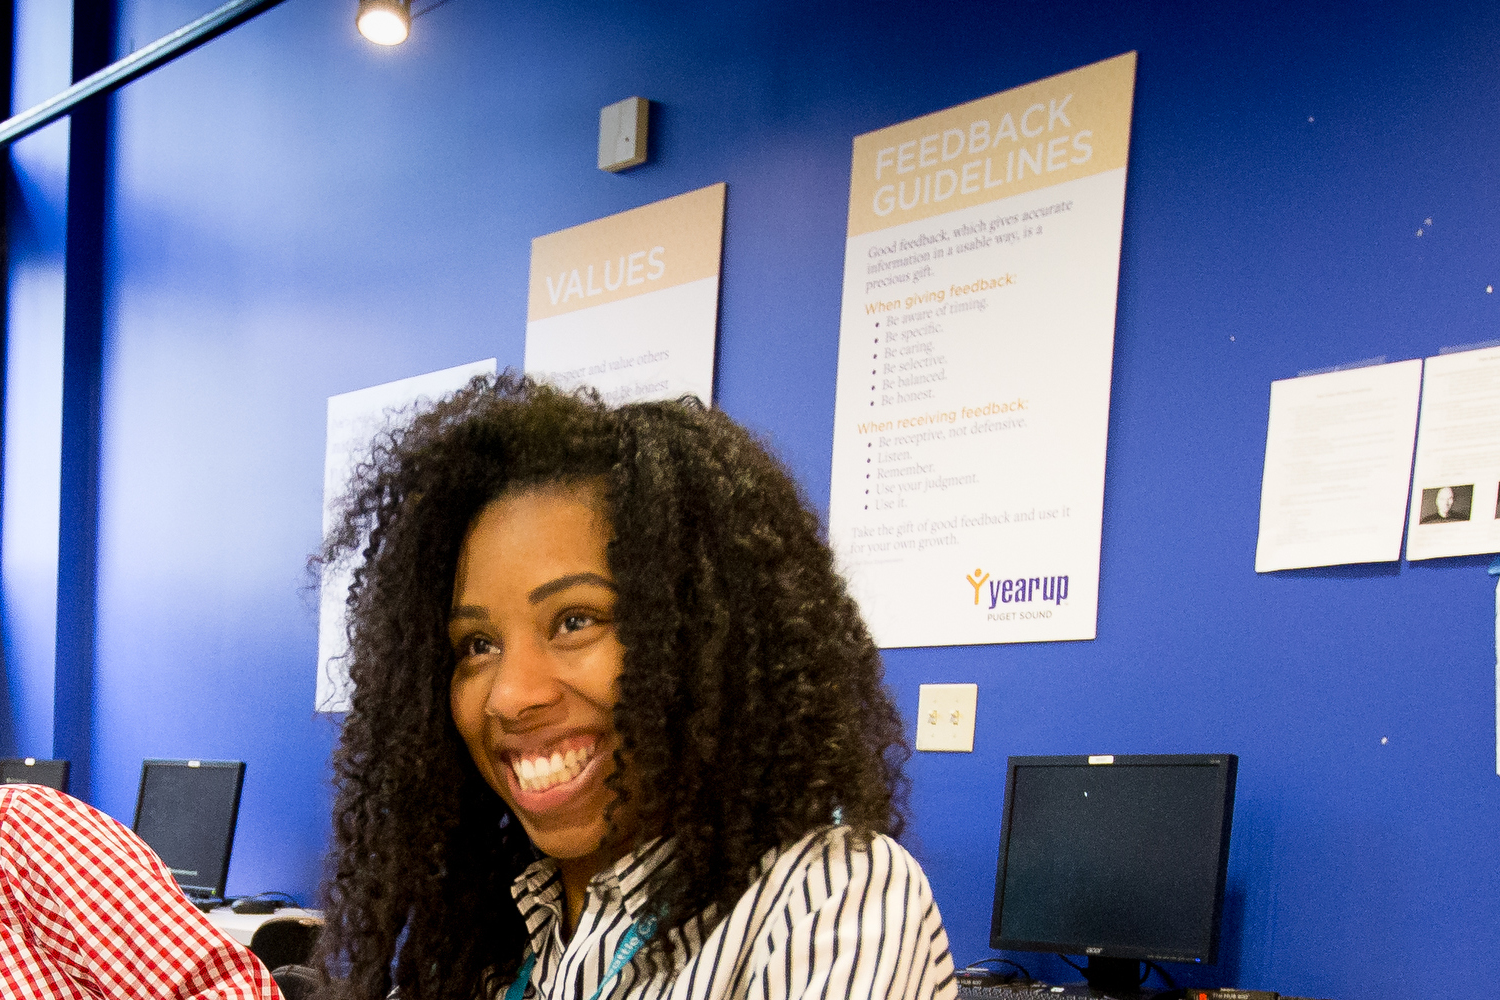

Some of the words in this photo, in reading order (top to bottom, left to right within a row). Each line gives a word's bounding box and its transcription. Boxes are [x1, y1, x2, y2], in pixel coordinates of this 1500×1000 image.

[875, 94, 1073, 180] FEEDBACK
[872, 129, 1093, 217] GUIDELINES
[868, 241, 897, 258] Good
[900, 229, 950, 251] feedback,
[953, 220, 987, 238] which
[989, 214, 1019, 232] gives
[1021, 200, 1074, 221] accurate
[867, 251, 931, 274] information
[933, 247, 944, 259] in
[947, 246, 953, 256] a
[956, 235, 991, 254] usable
[994, 231, 1020, 246] way,
[1022, 226, 1033, 239] is
[1036, 224, 1043, 235] a
[546, 246, 665, 305] VALUES
[865, 272, 911, 294] precious
[912, 264, 935, 284] gift.
[865, 299, 901, 315] When
[905, 289, 945, 309] giving
[950, 273, 1017, 297] feedback:
[886, 315, 899, 327] Be
[901, 310, 933, 324] aware
[935, 302, 949, 316] of
[885, 331, 898, 343] Be
[588, 360, 606, 375] and
[636, 350, 670, 365] others
[884, 347, 897, 359] Be
[883, 362, 896, 375] Be
[882, 378, 895, 390] Be
[881, 394, 894, 406] Be
[857, 420, 893, 435] When
[897, 411, 957, 429] receiving
[961, 398, 1028, 419] feedback:
[878, 435, 891, 448] Be
[949, 426, 967, 438] not
[876, 483, 896, 495] Use
[898, 481, 922, 496] your
[875, 499, 895, 511] Use
[851, 525, 875, 539] Take
[877, 523, 894, 536] the
[896, 520, 914, 538] gift
[917, 518, 930, 532] of
[930, 516, 958, 535] good
[960, 510, 1011, 528] feedback
[1013, 507, 1036, 523] and
[1038, 508, 1059, 520] use
[1062, 505, 1071, 518] it
[849, 541, 864, 554] for
[866, 541, 891, 556] your
[893, 538, 916, 551] own
[918, 533, 960, 552] growth.
[987, 612, 1017, 621] PUGET
[1019, 610, 1053, 620] SOUND
